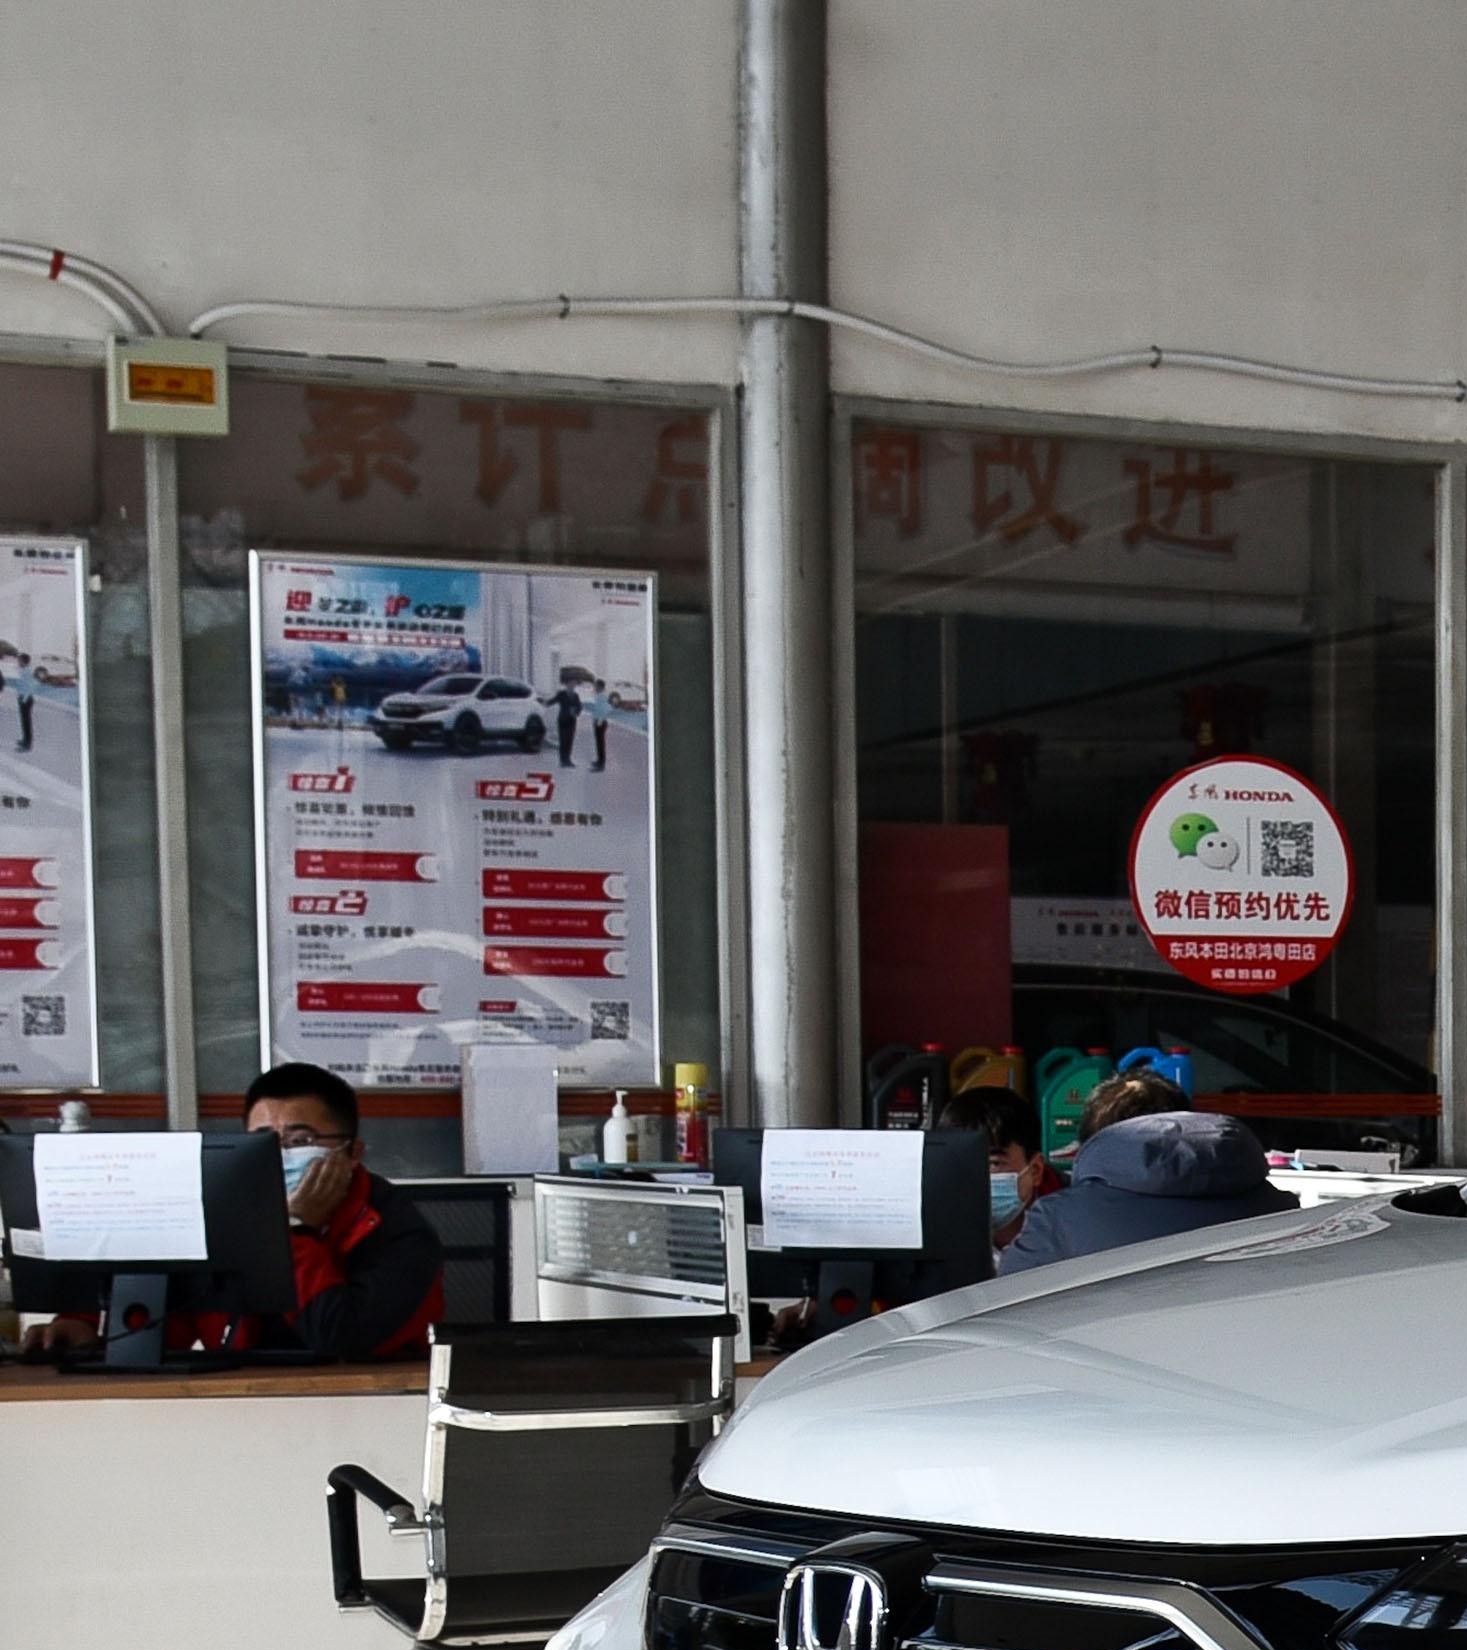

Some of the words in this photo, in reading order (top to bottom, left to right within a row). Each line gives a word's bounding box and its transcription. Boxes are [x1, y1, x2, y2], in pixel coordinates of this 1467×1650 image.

[1224, 789, 1294, 803] HONDA
[1154, 889, 1331, 922] 微信预约优先
